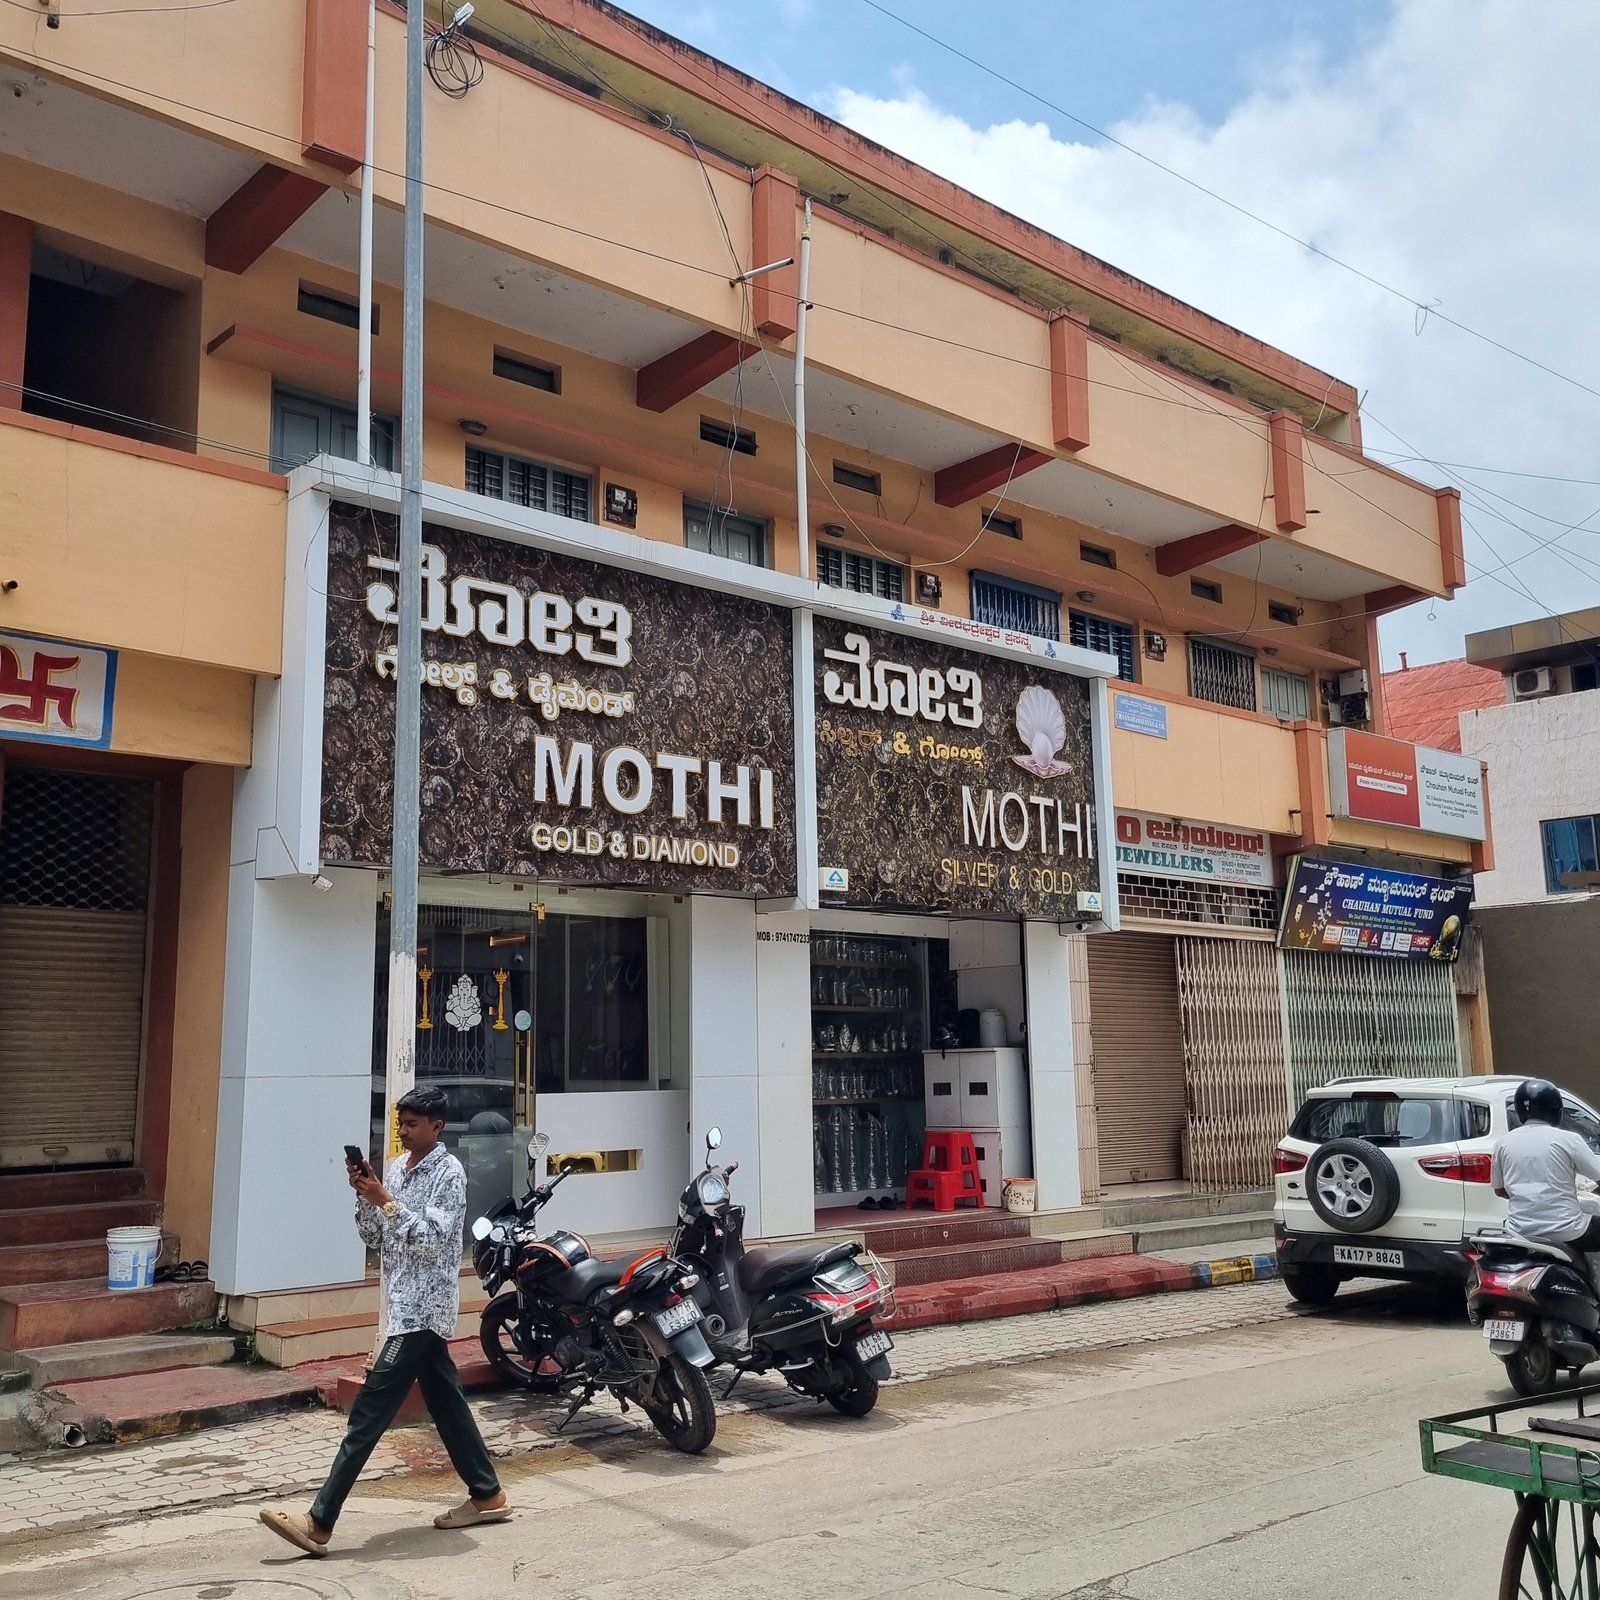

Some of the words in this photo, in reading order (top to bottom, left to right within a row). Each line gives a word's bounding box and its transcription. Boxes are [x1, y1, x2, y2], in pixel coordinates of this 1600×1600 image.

[366, 543, 633, 668] ಮೋತಿ
[489, 668, 519, 700] &
[824, 632, 983, 730] ಮೋತಿ
[893, 731, 912, 755] &
[533, 734, 775, 831] MOTHI
[1425, 780, 1447, 792] Chauhan
[1447, 784, 1464, 796] Mutual
[1464, 788, 1476, 798] Fund
[961, 785, 1094, 859] MOTHI
[530, 821, 603, 857] GOLD
[608, 829, 629, 860] &
[633, 833, 741, 869] DIAMOND
[941, 858, 998, 889] SILVER
[1009, 870, 1020, 889] &
[1030, 868, 1073, 896] GOLD
[1342, 899, 1381, 913] CHAUHAN
[1381, 903, 1412, 917] MUTUAL
[1413, 908, 1434, 920] FUND
[757, 931, 771, 942] MOB
[776, 932, 810, 944] 9741747233
[1344, 928, 1358, 937] TATA
[1340, 1248, 1364, 1261] KA17
[1366, 1250, 1373, 1262] P
[1376, 1251, 1401, 1265] 8849
[1490, 1330, 1515, 1340] P3861
[1491, 1320, 1517, 1331] KA17E
